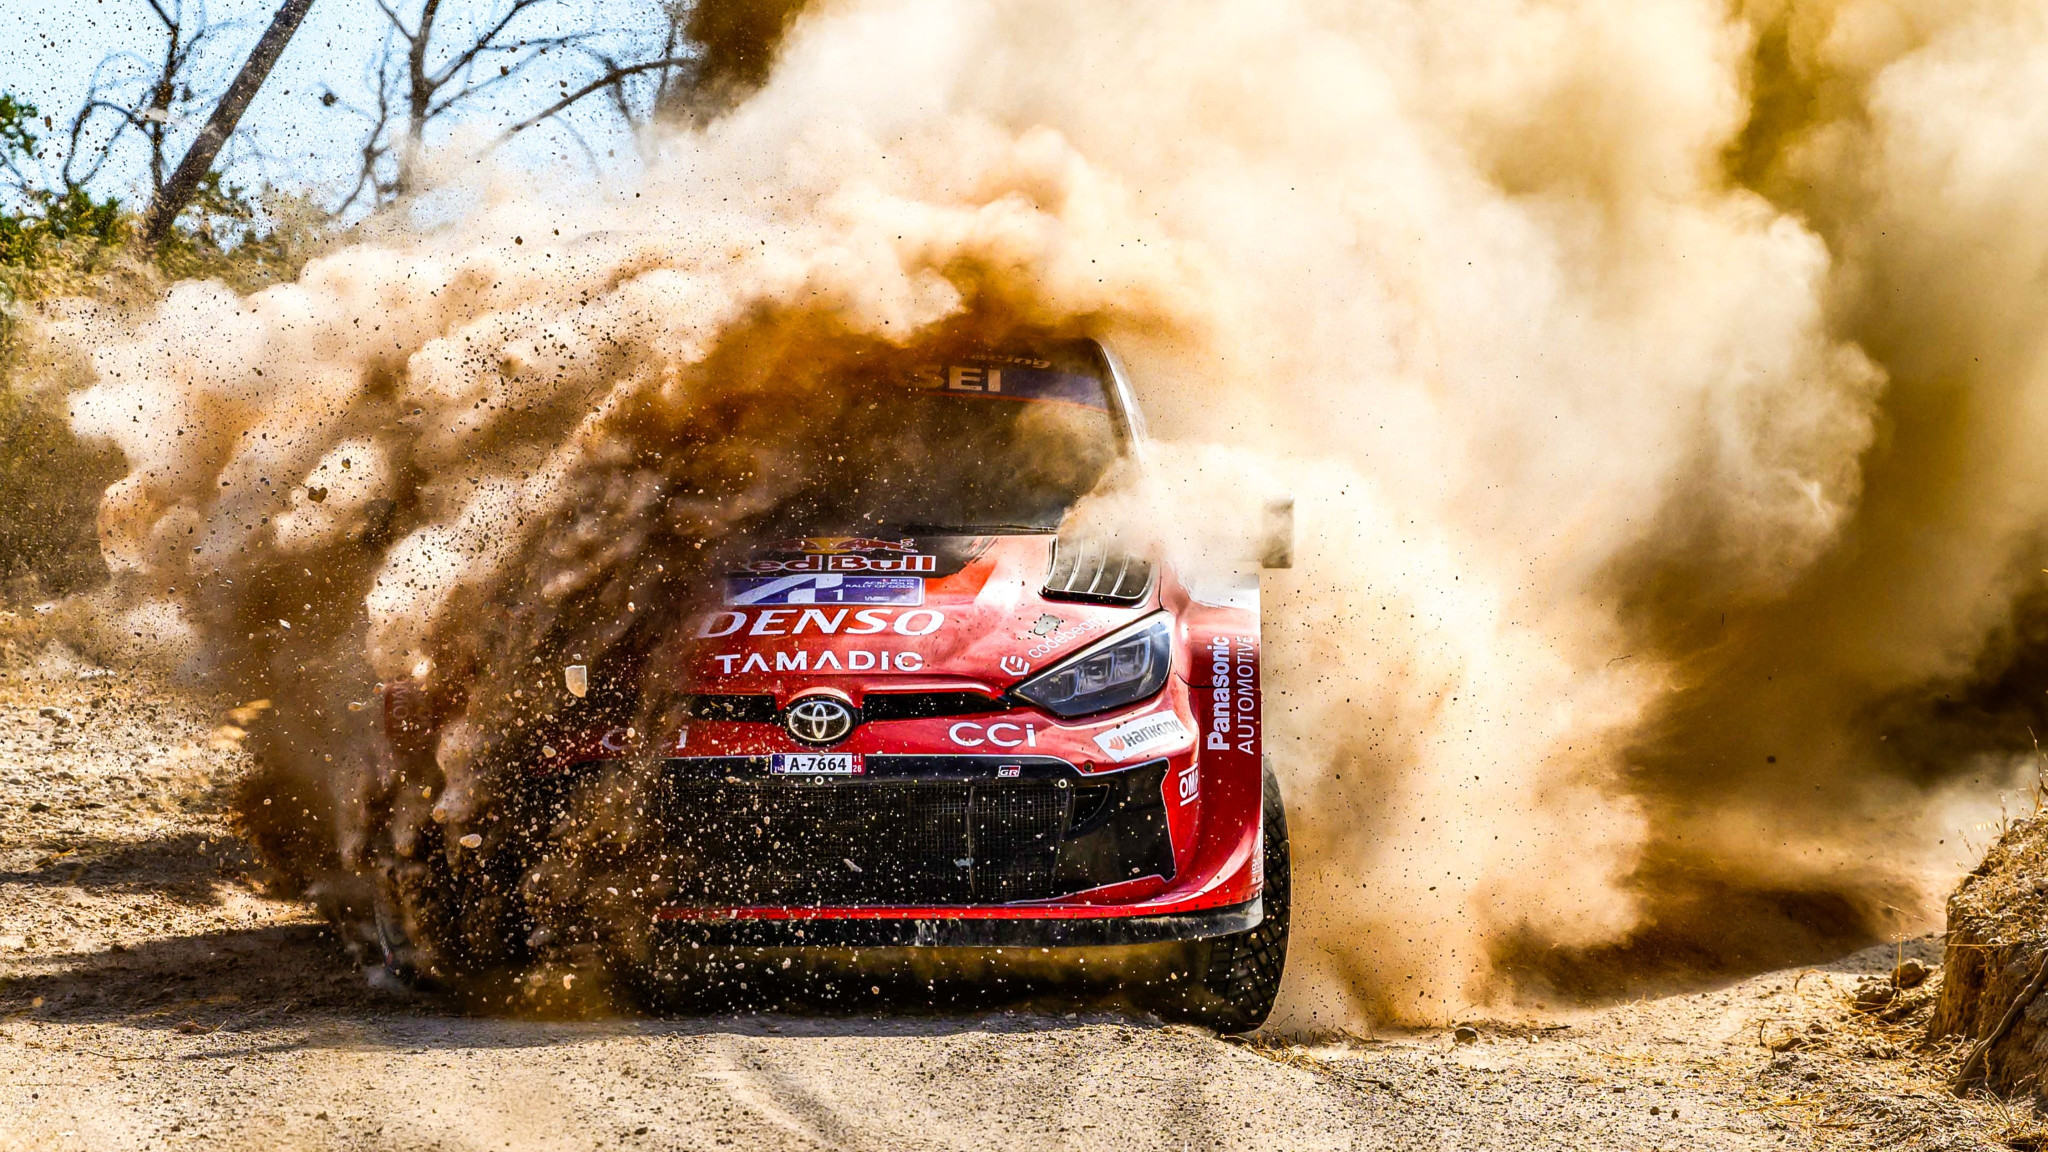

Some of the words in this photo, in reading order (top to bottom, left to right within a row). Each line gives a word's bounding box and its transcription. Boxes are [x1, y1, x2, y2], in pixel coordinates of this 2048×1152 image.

[738, 555, 823, 573] ed
[828, 555, 936, 572] Bull
[833, 589, 844, 601] 1
[697, 609, 945, 638] DENSO
[715, 651, 924, 674] TAMADIC
[1207, 636, 1230, 750] Panasonic
[1237, 635, 1255, 755] AUTOMOTIVE
[790, 757, 847, 771] A-7664
[853, 765, 862, 773] 26
